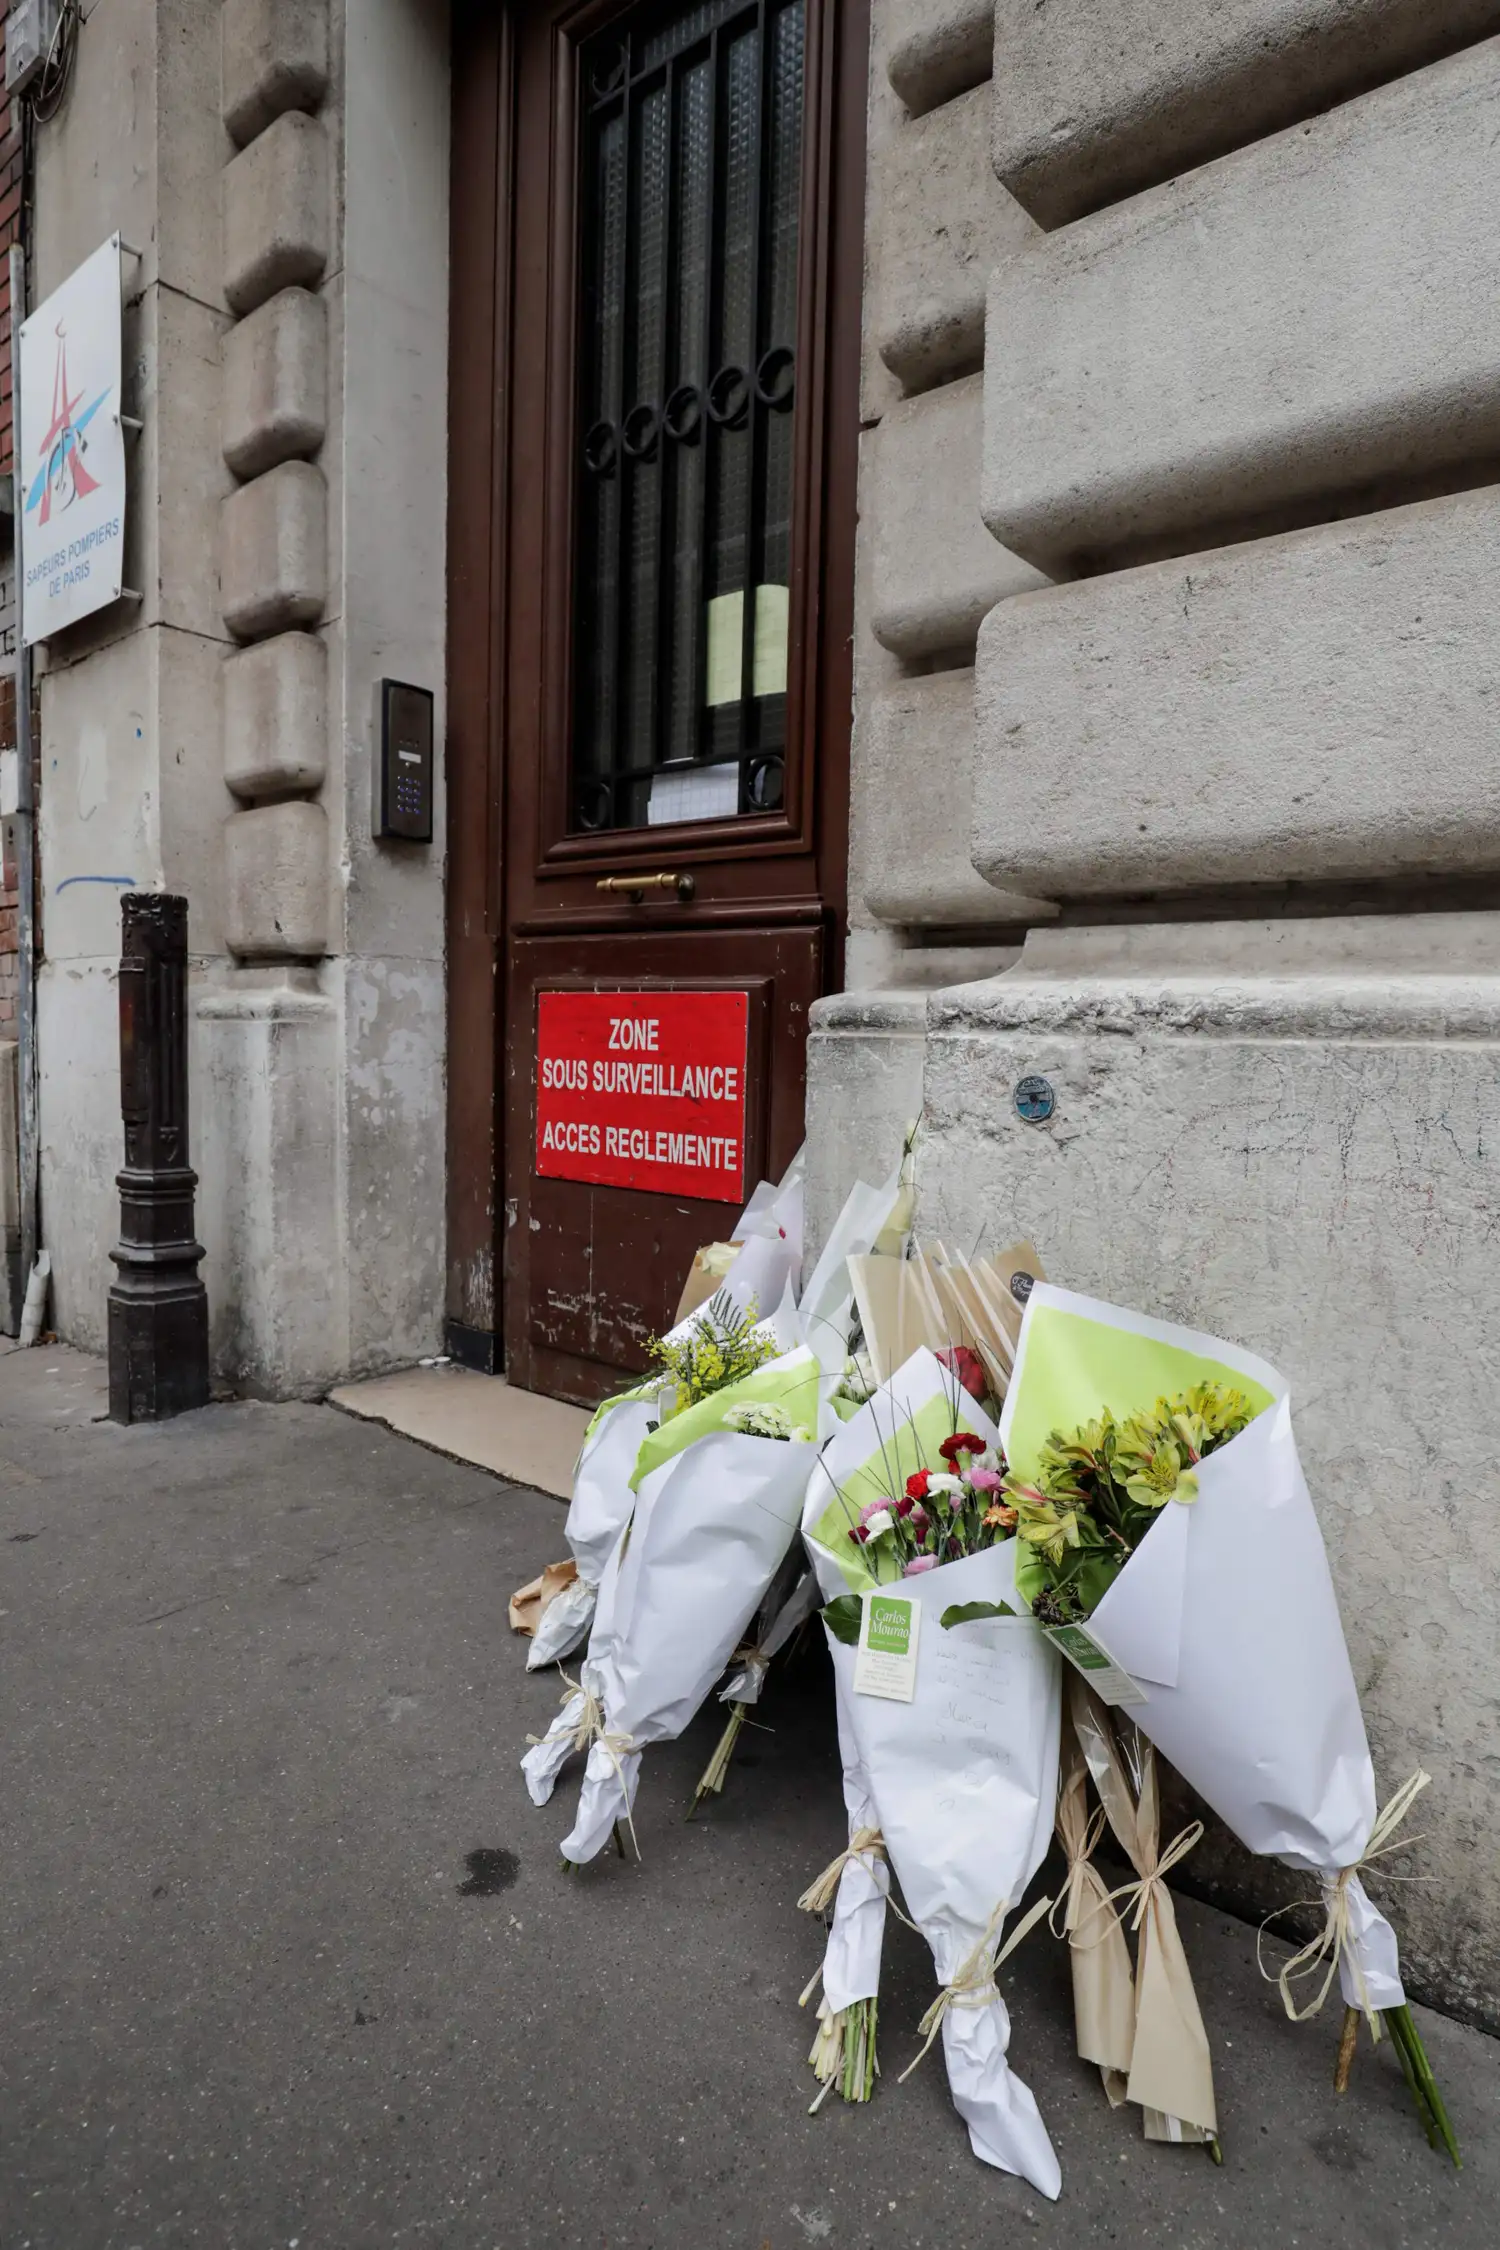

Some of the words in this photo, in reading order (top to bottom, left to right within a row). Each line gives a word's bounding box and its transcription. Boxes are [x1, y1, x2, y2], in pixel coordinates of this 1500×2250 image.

[26, 549, 66, 587] SAPEURS
[68, 518, 120, 562] POMPIERS
[50, 577, 61, 597] DE
[63, 561, 91, 589] PARIS
[608, 1018, 659, 1051] ZONE
[542, 1058, 588, 1091] SOUS
[592, 1061, 738, 1101] SURVEILLANCE
[542, 1121, 600, 1155] ACCES
[605, 1126, 737, 1171] REGLEMENTE
[875, 1608, 907, 1625] Carlos
